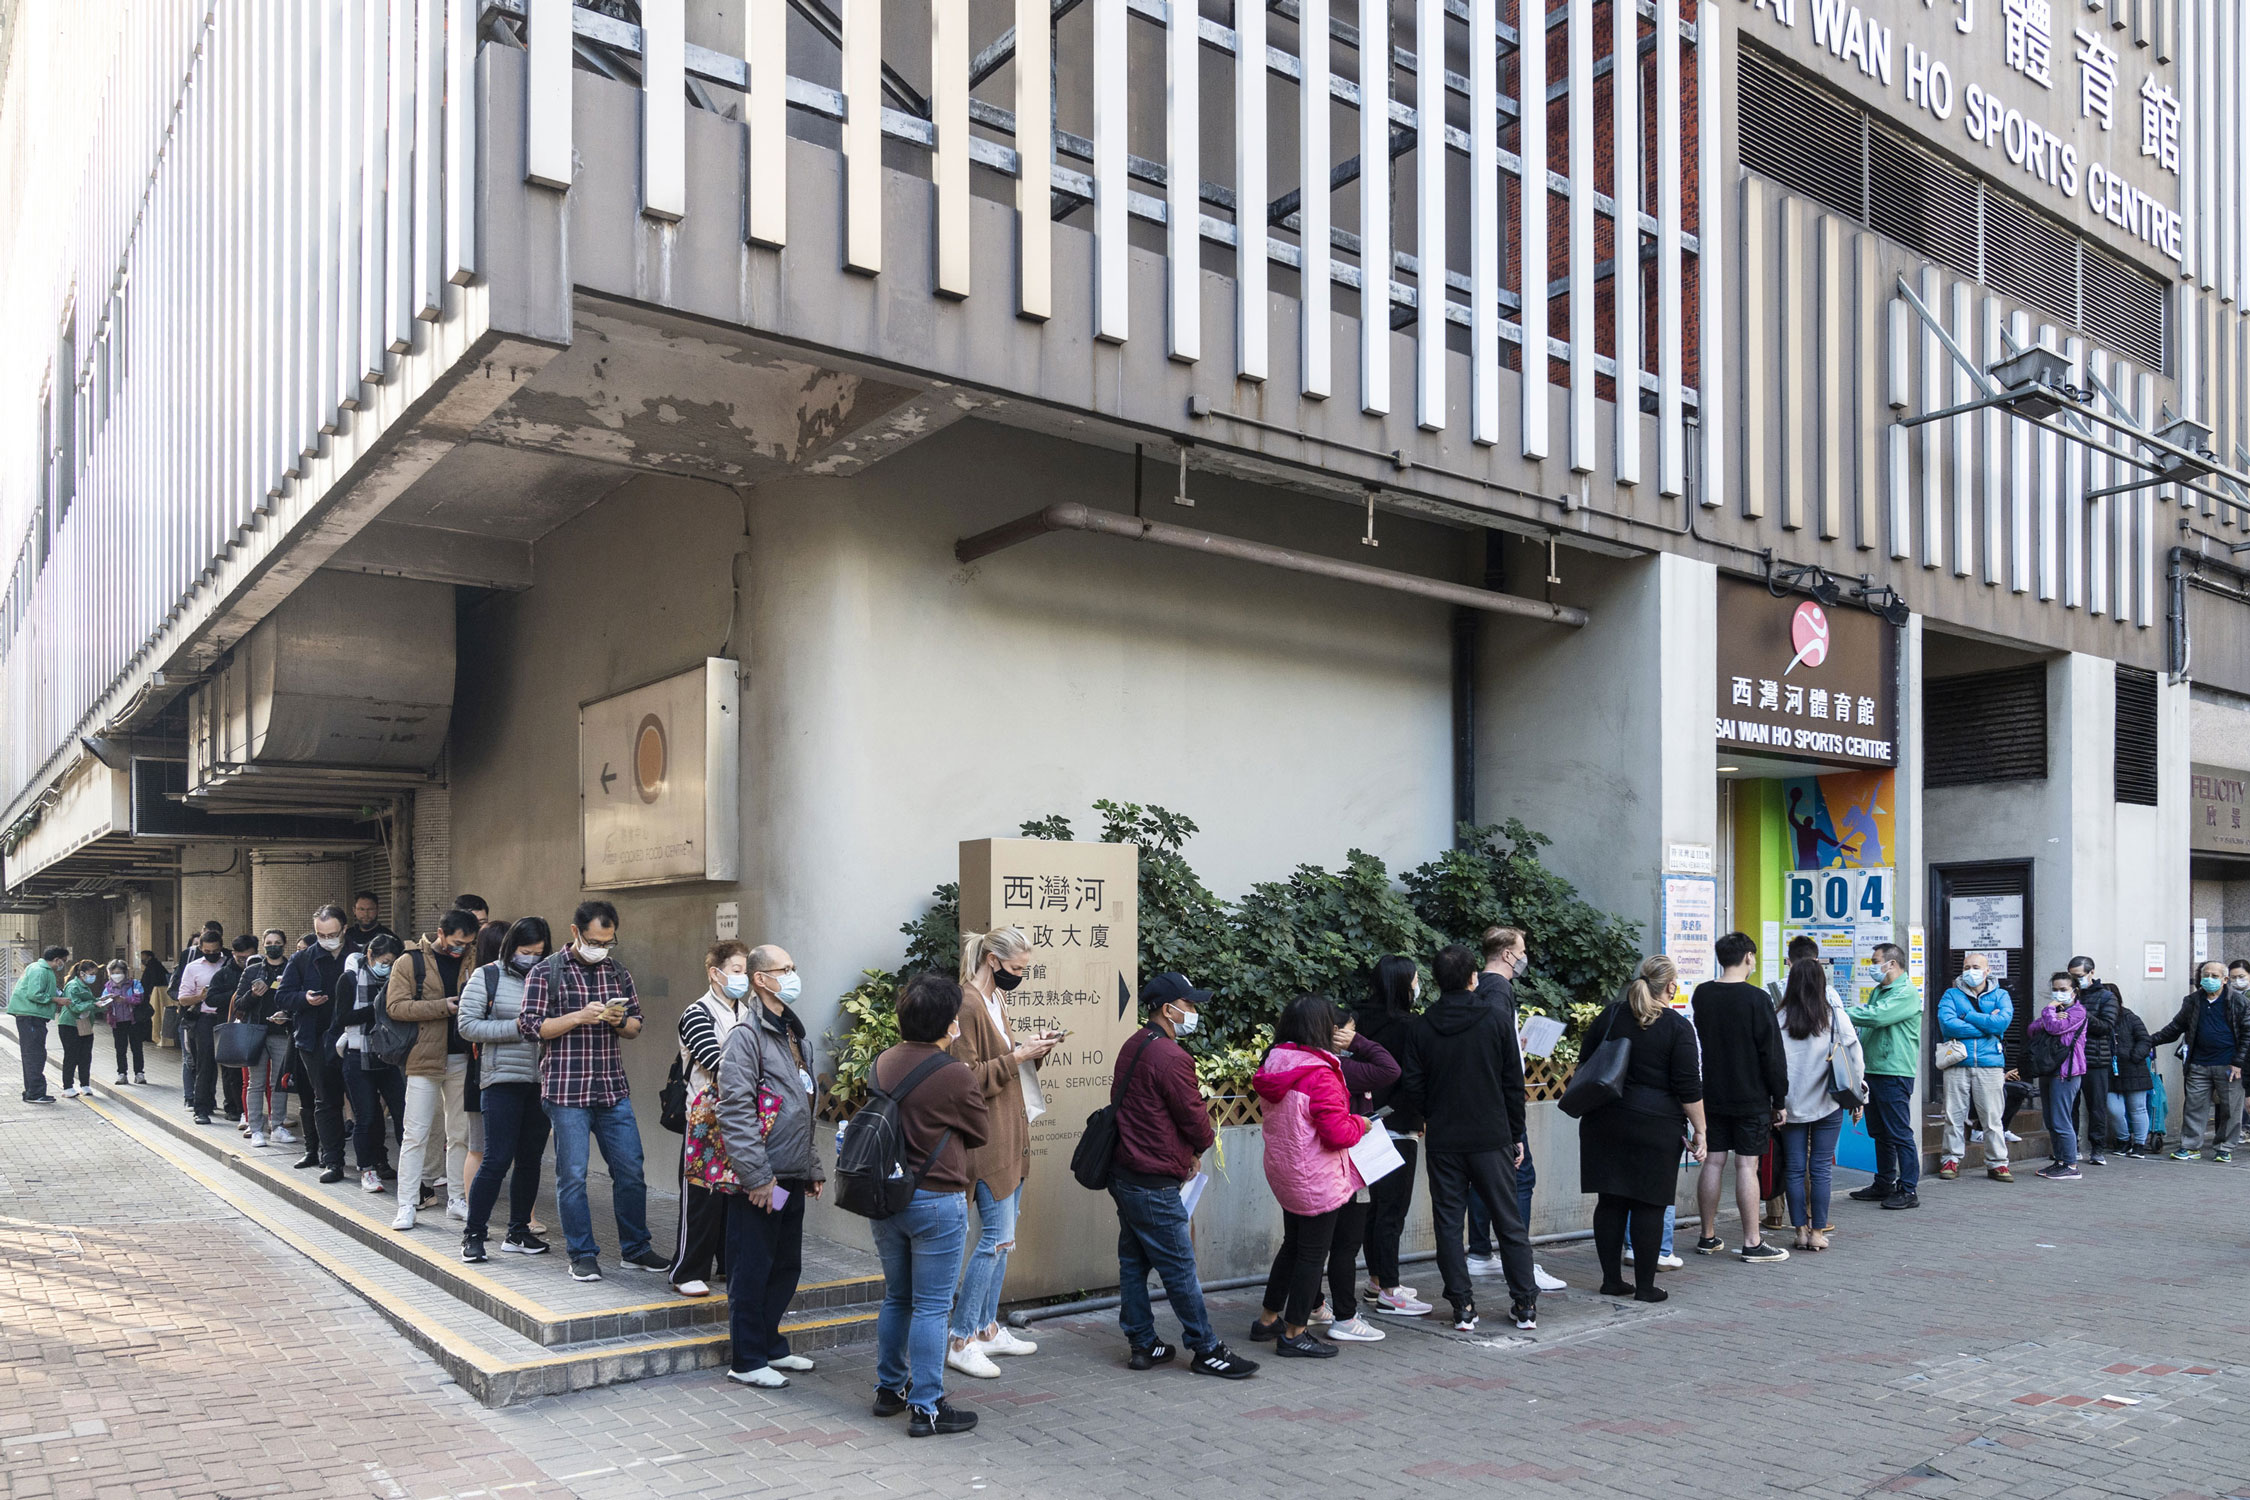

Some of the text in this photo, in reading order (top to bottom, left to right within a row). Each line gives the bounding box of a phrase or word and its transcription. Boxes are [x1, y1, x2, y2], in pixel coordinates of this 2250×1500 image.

[1811, 0, 2182, 262] WAN HO SPORTS CENTRE
[1731, 676, 1875, 727] 西灣河體育館
[1716, 718, 1891, 760] SAI WAN HO SPORTS CENTRE
[2191, 775, 2245, 805] FELICITY
[1003, 875, 1105, 912] 西灣河
[1012, 923, 1110, 949] 政大廈
[1082, 1050, 1103, 1065] HO
[1066, 1075, 1113, 1088] SERVICES
[1031, 1119, 1057, 1128] CENTRE
[1046, 1133, 1072, 1141] COOKED
[1031, 1149, 1048, 1157] NTRE
